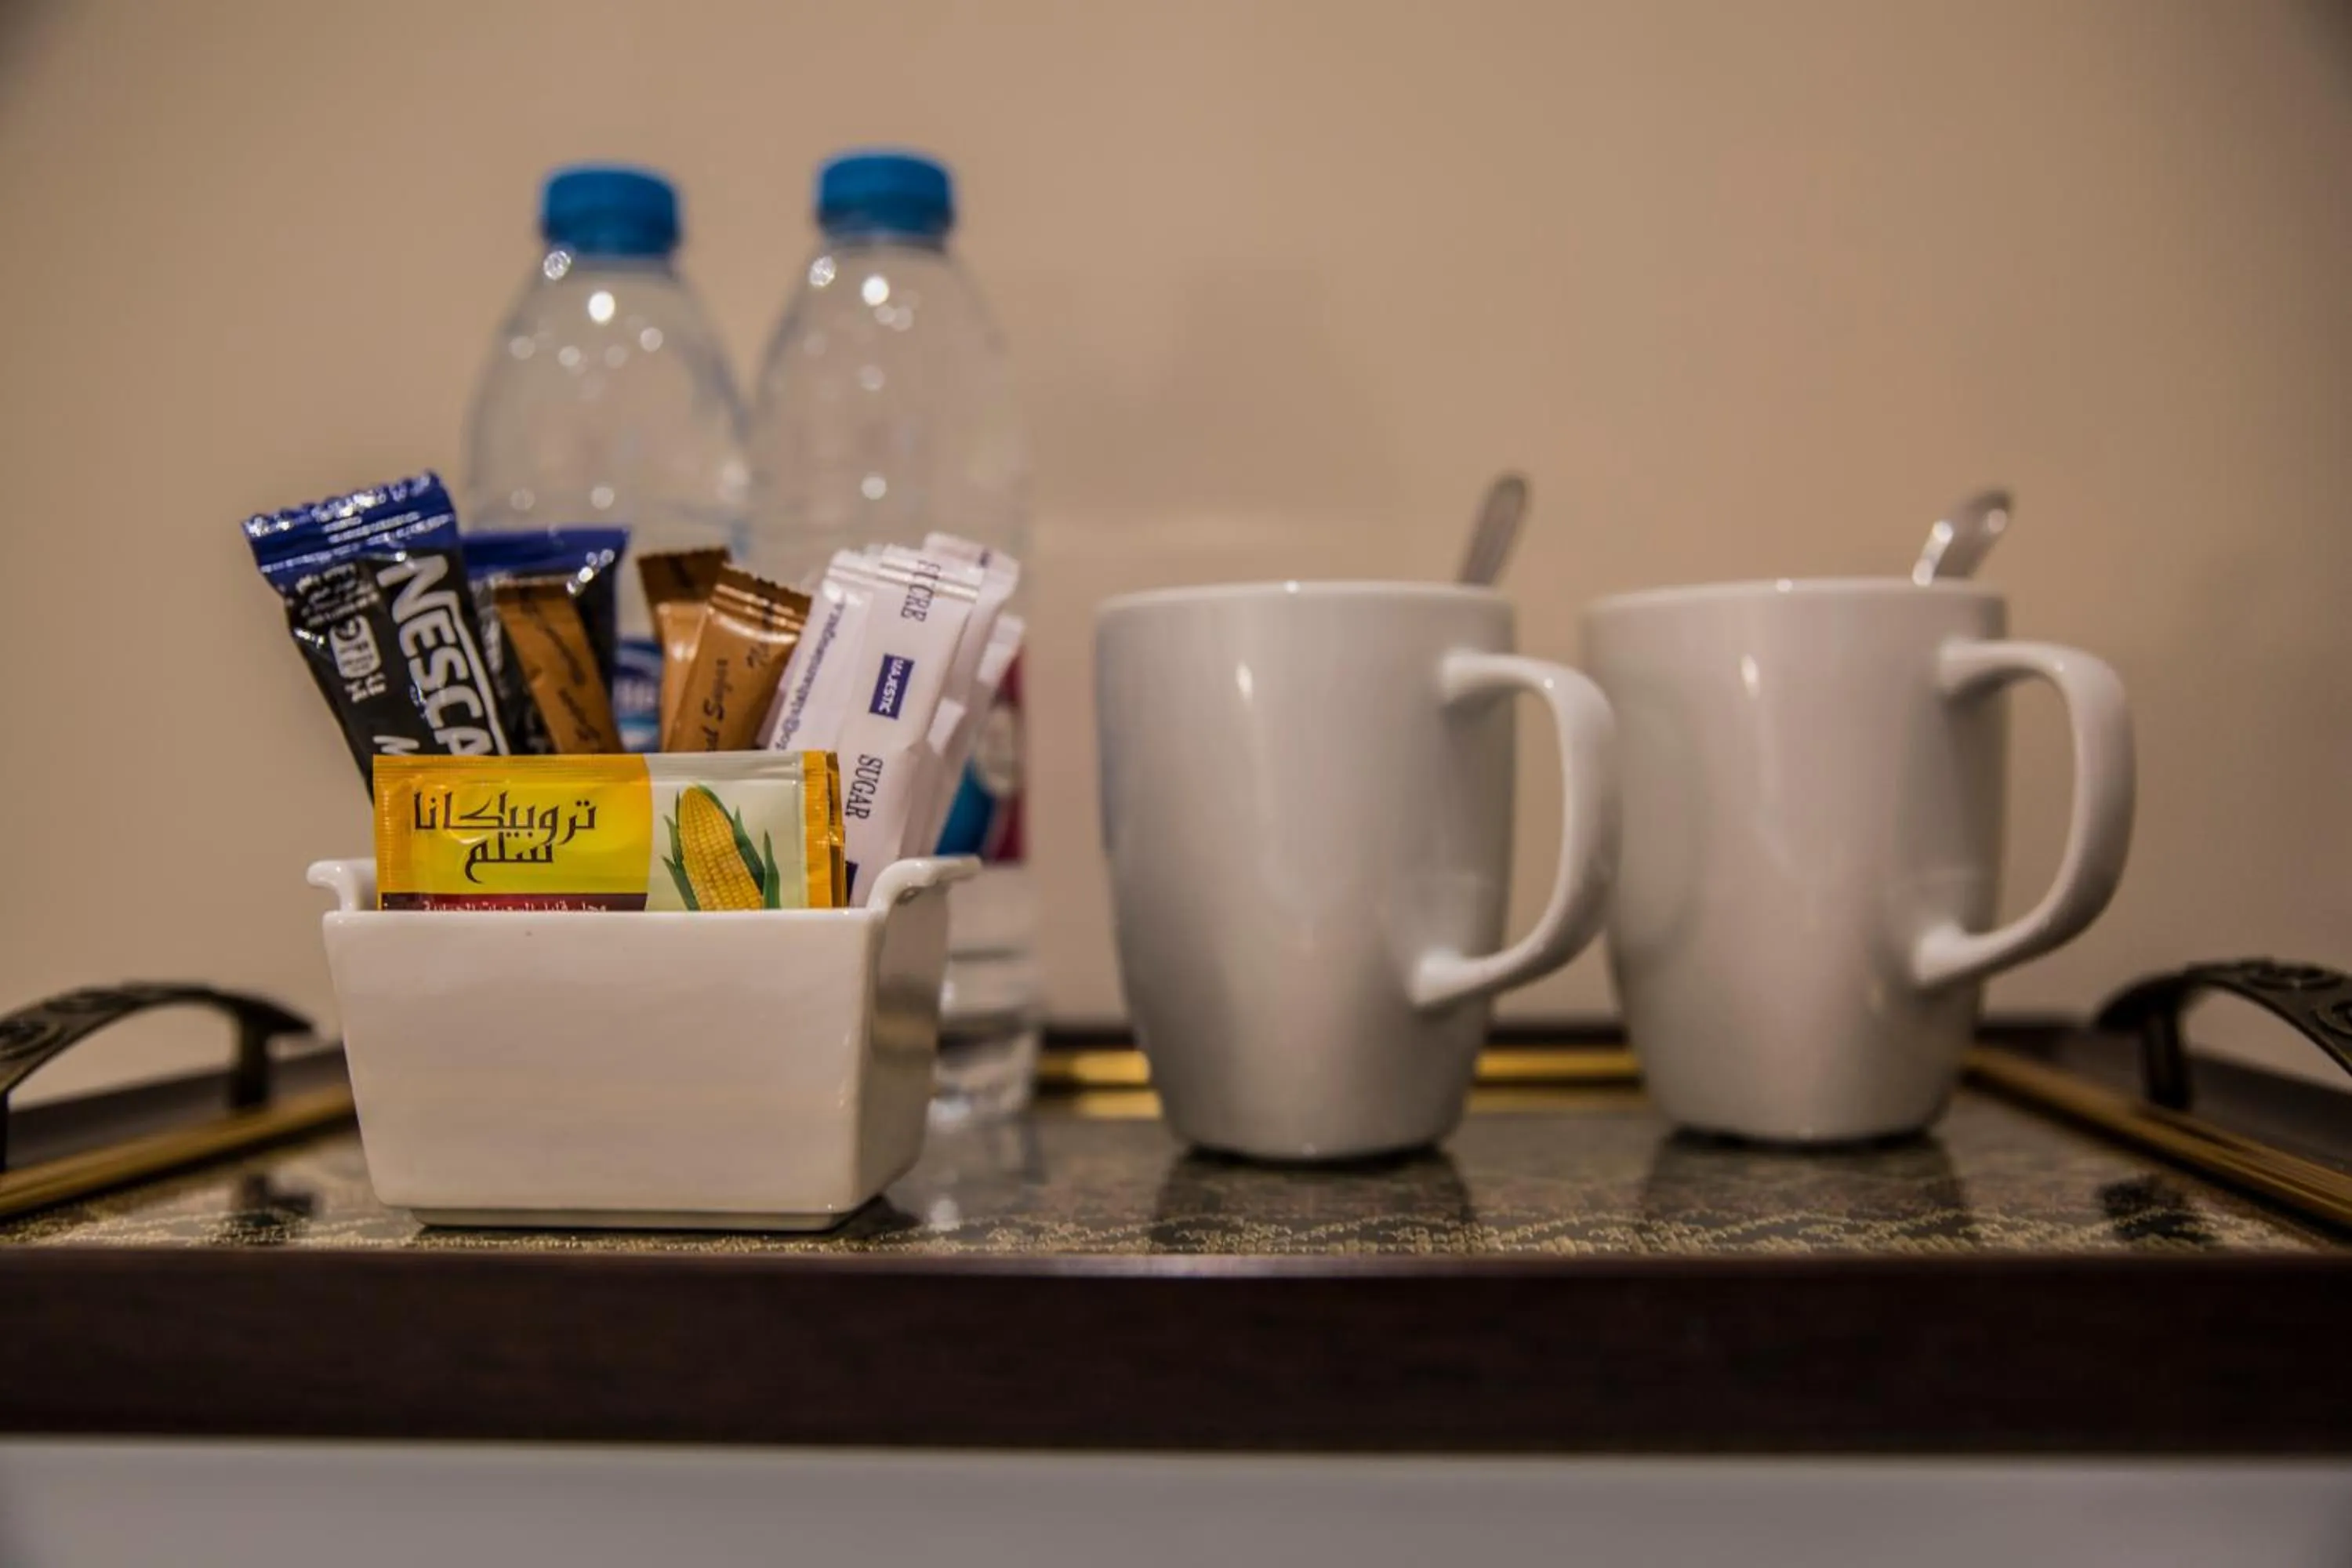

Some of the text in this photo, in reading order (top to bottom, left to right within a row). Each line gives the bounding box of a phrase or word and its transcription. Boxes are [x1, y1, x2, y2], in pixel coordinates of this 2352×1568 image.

[877, 657, 906, 715] MAJESTIC
[845, 754, 884, 819] SUGAR
[414, 790, 597, 846] تروبيكانا
